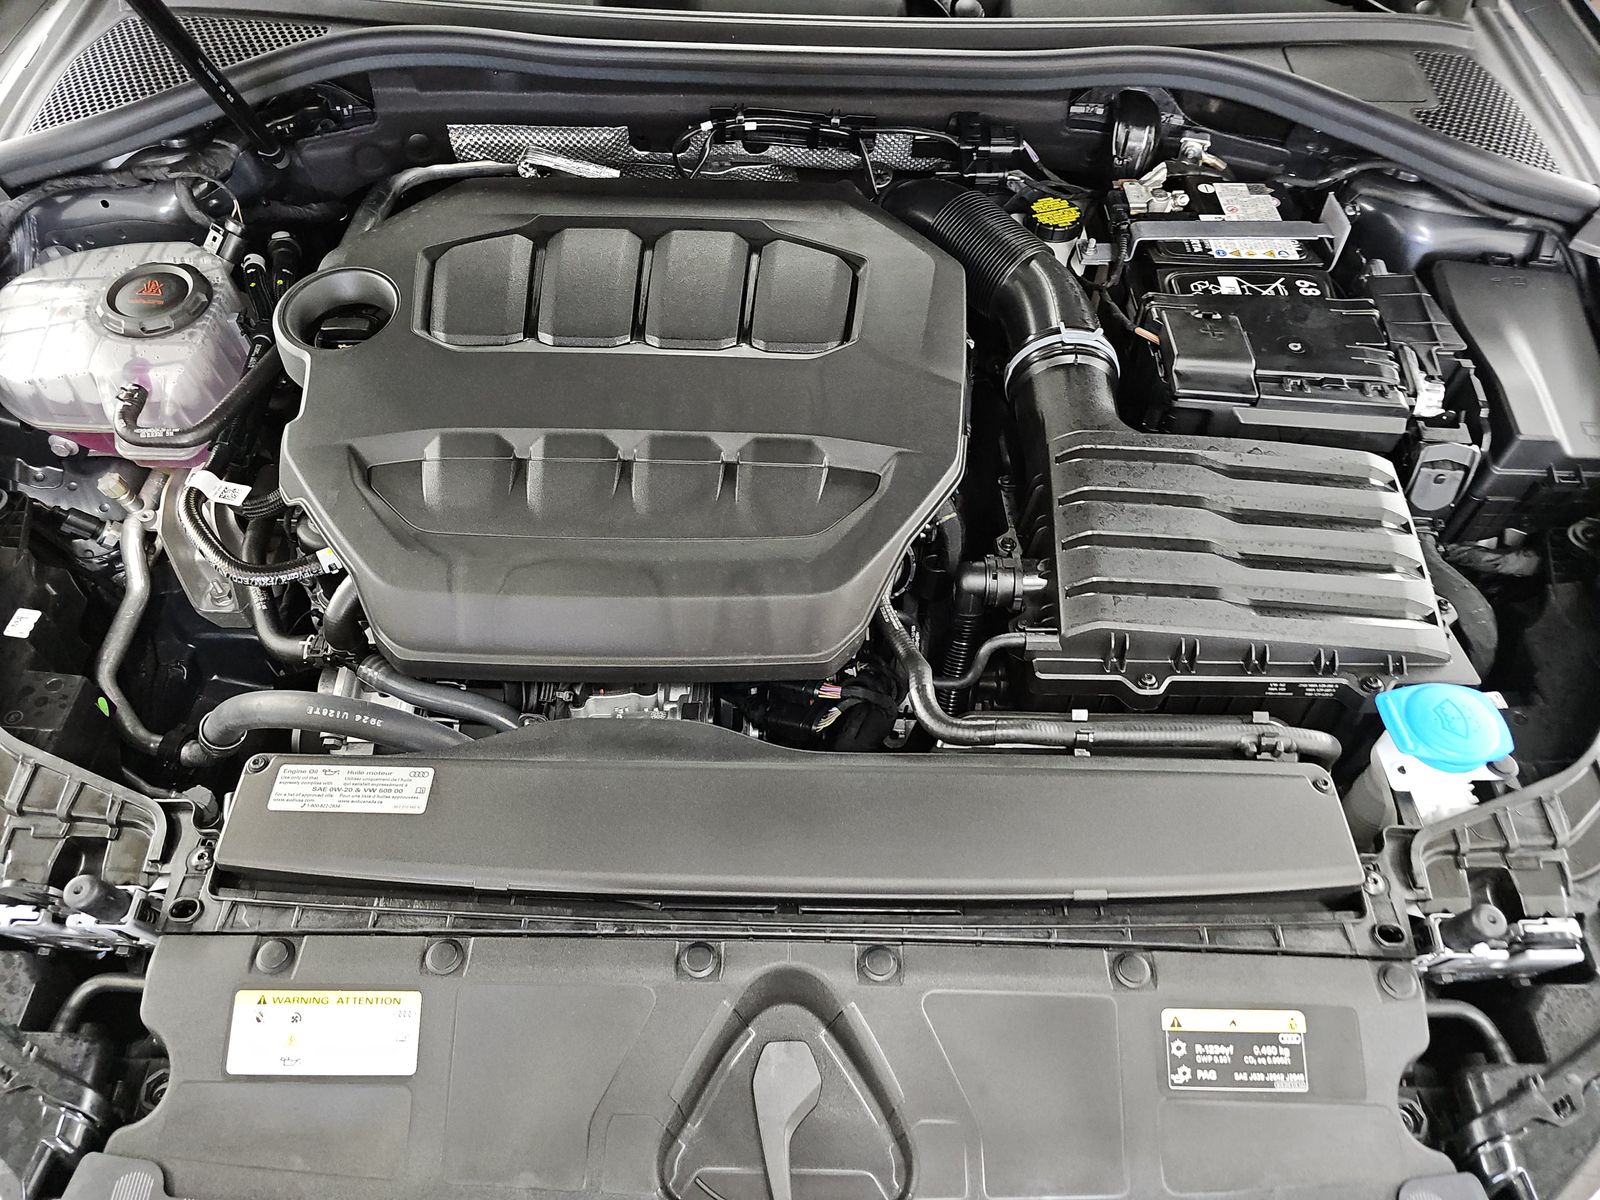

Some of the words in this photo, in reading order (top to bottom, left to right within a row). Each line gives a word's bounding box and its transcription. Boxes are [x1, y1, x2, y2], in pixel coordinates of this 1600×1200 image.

[1295, 280, 1321, 296] 68
[272, 996, 329, 1005] WARNING
[336, 996, 402, 1006] ATTENTION
